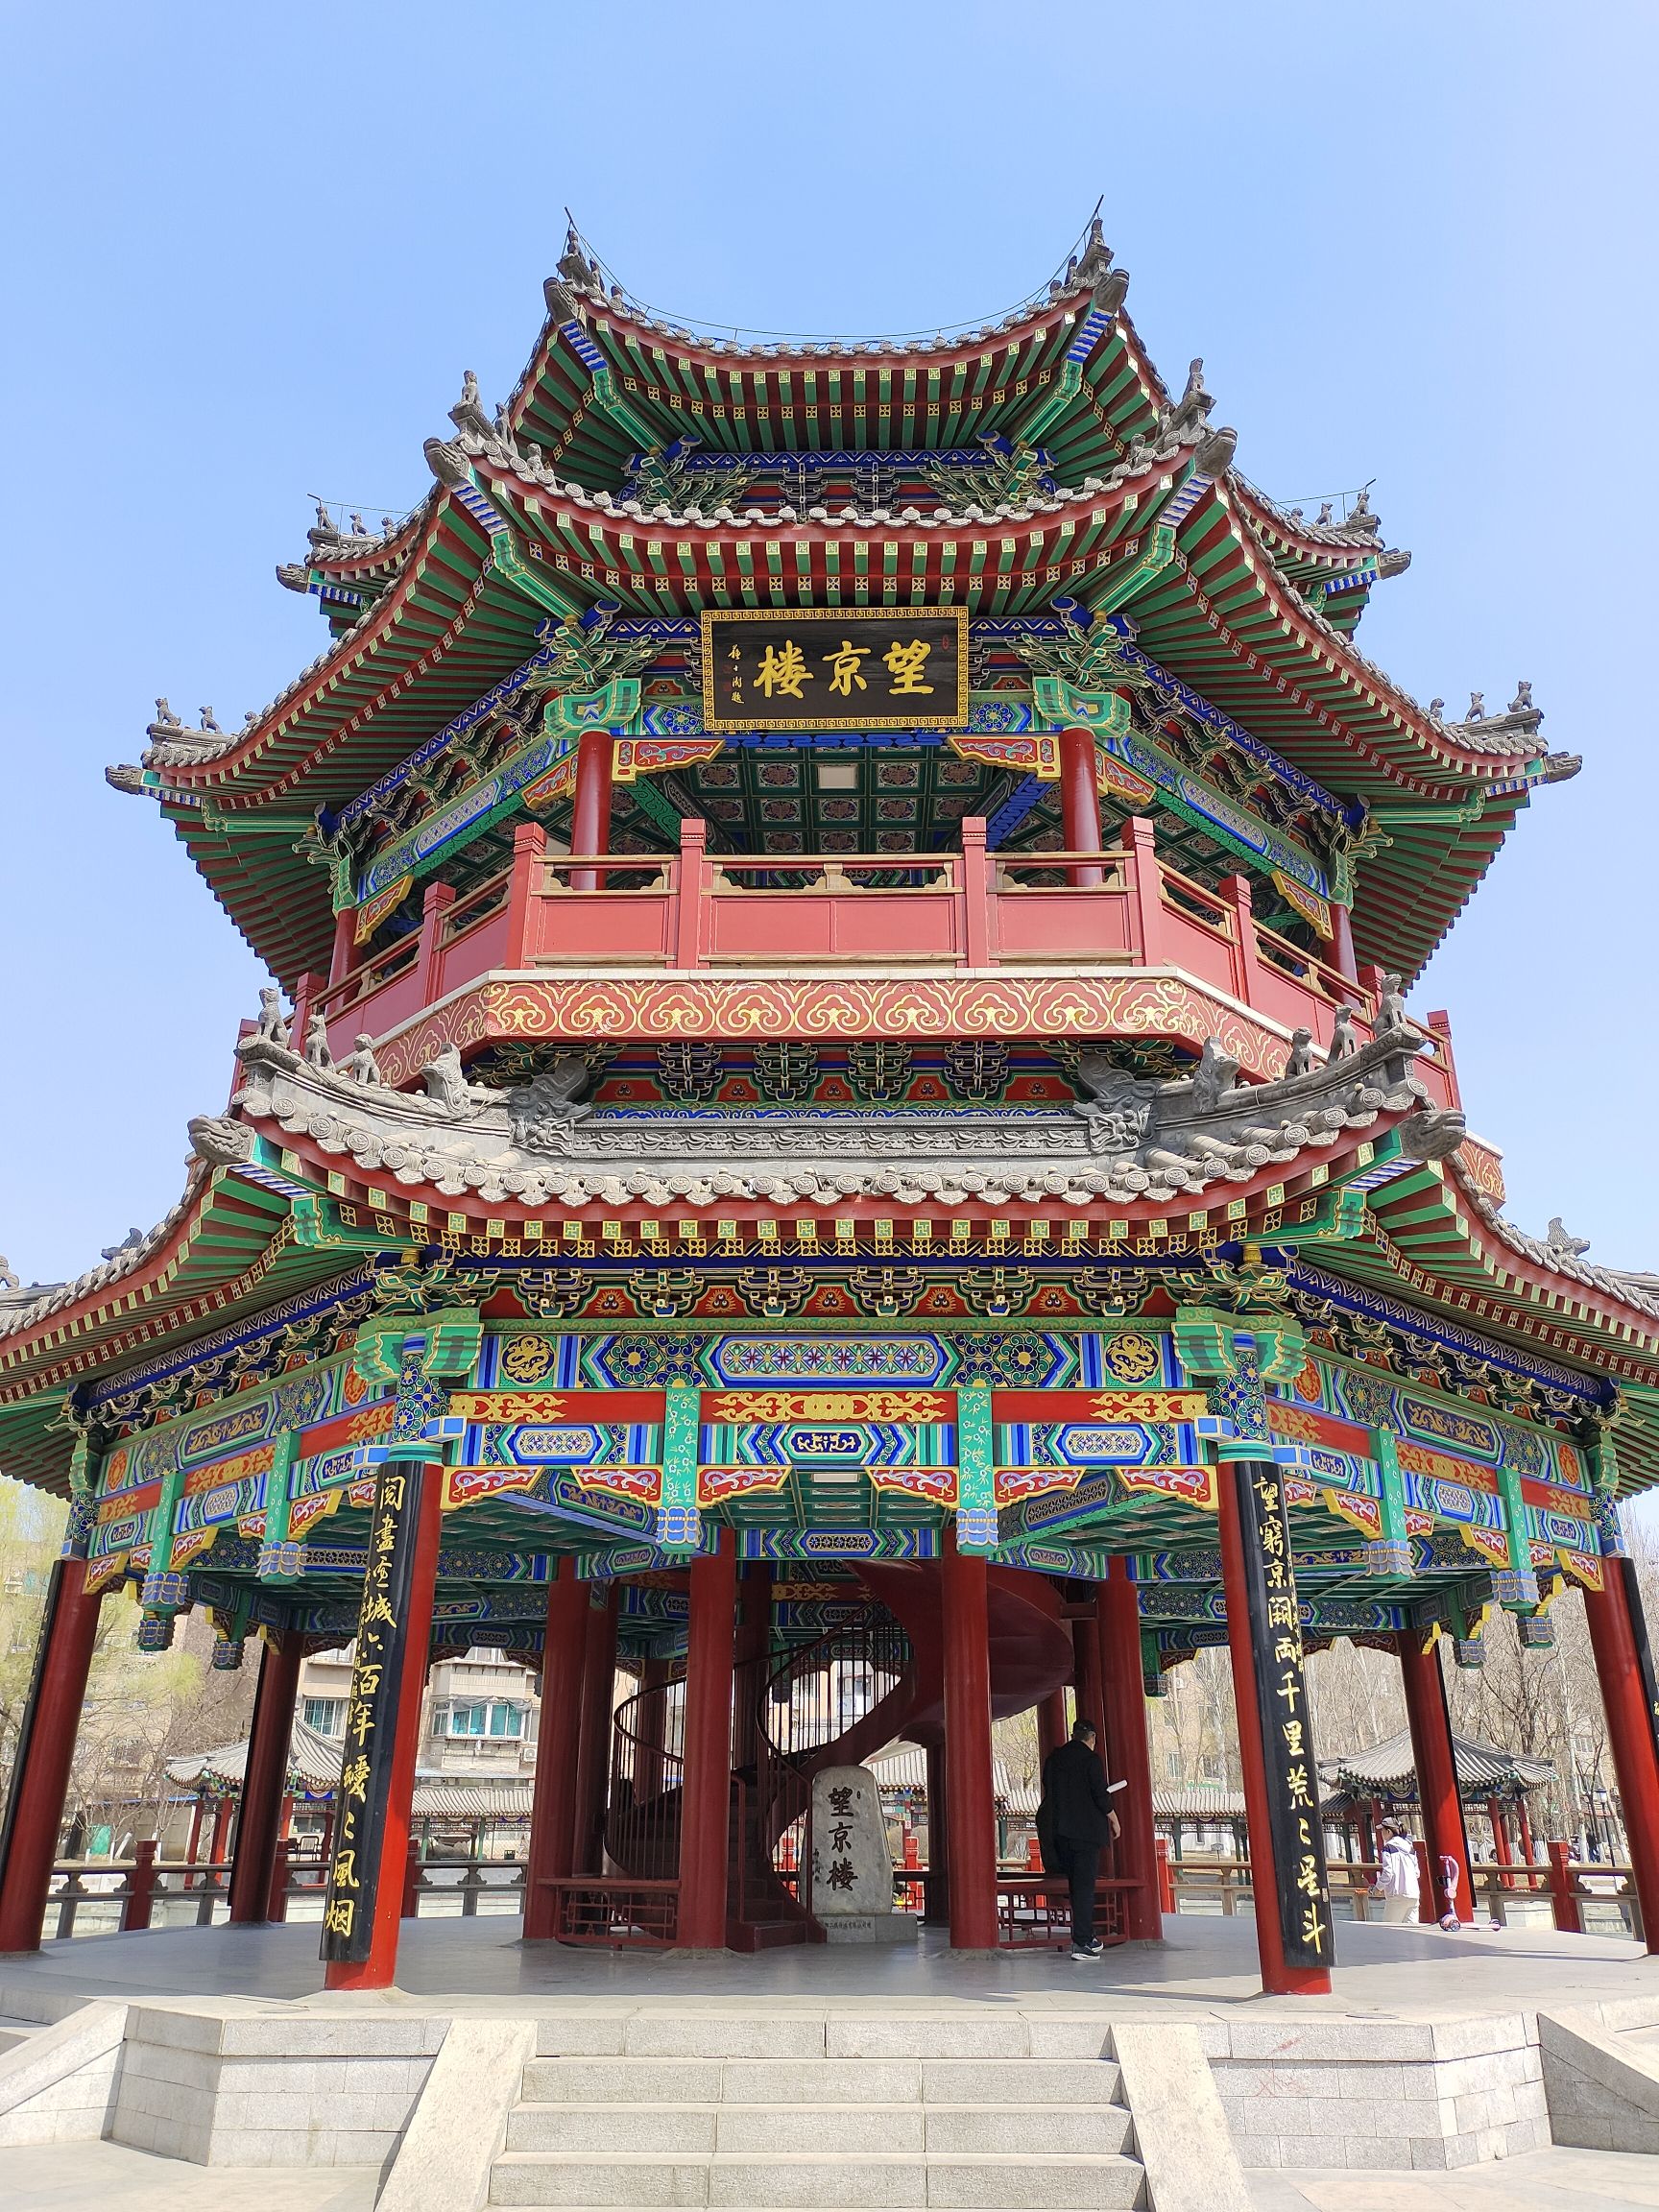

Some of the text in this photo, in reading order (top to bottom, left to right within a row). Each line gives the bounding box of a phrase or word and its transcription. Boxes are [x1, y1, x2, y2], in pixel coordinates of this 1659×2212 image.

[753, 638, 934, 700] 望京楼
[826, 1786, 858, 1891] 望京楼
